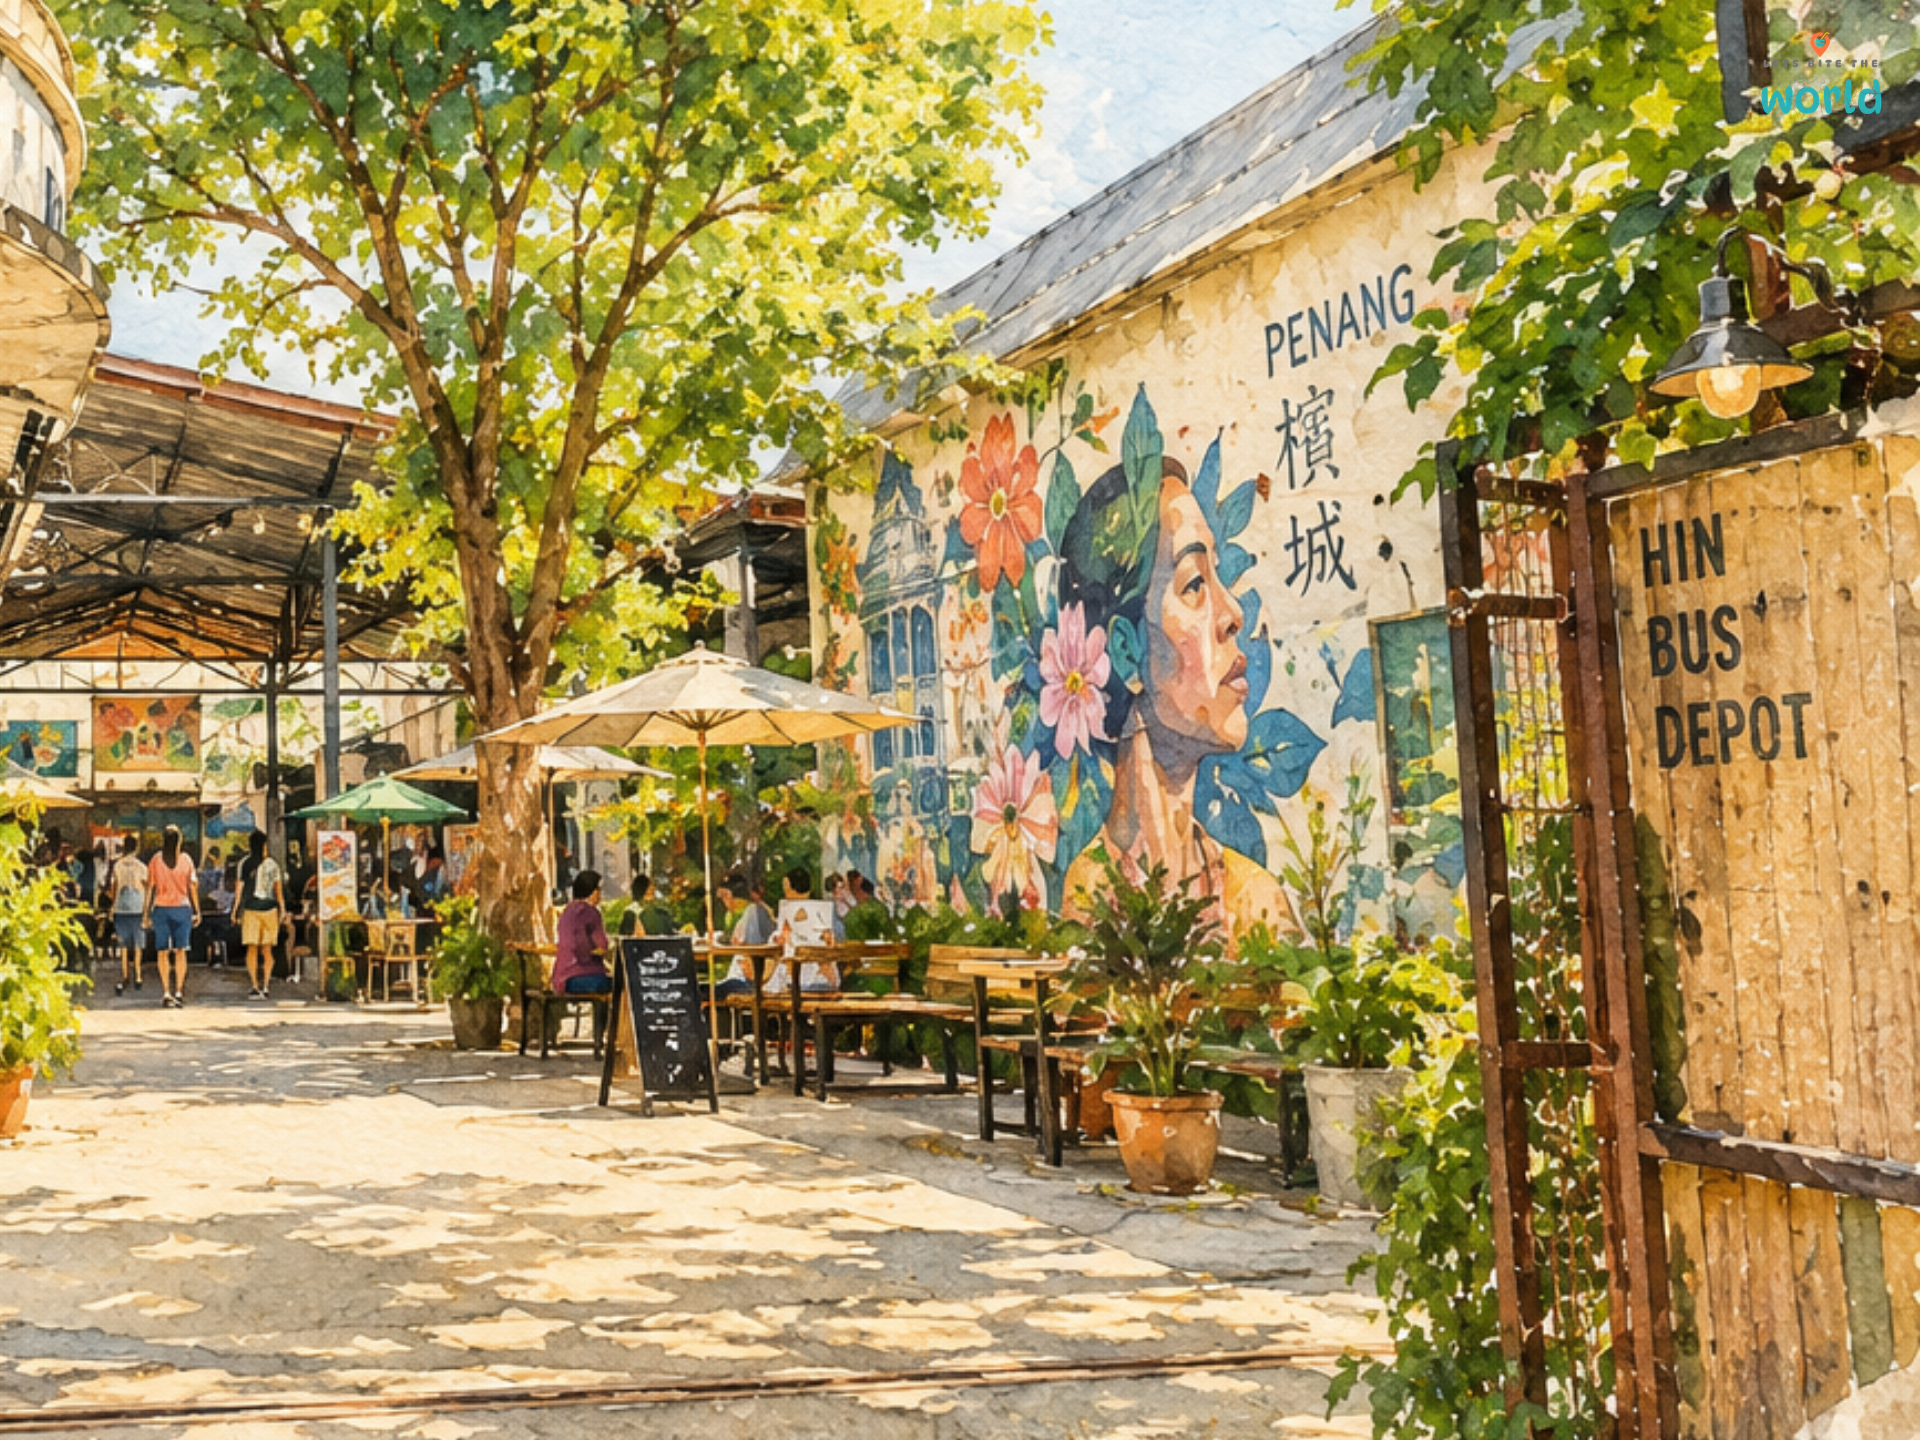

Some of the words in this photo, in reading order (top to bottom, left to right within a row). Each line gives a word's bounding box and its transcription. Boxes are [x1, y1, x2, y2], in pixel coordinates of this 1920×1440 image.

[1265, 264, 1415, 379] PENANG
[1640, 513, 1726, 588] HIN
[1647, 605, 1742, 678] BUS
[1655, 692, 1812, 769] DEPOT
